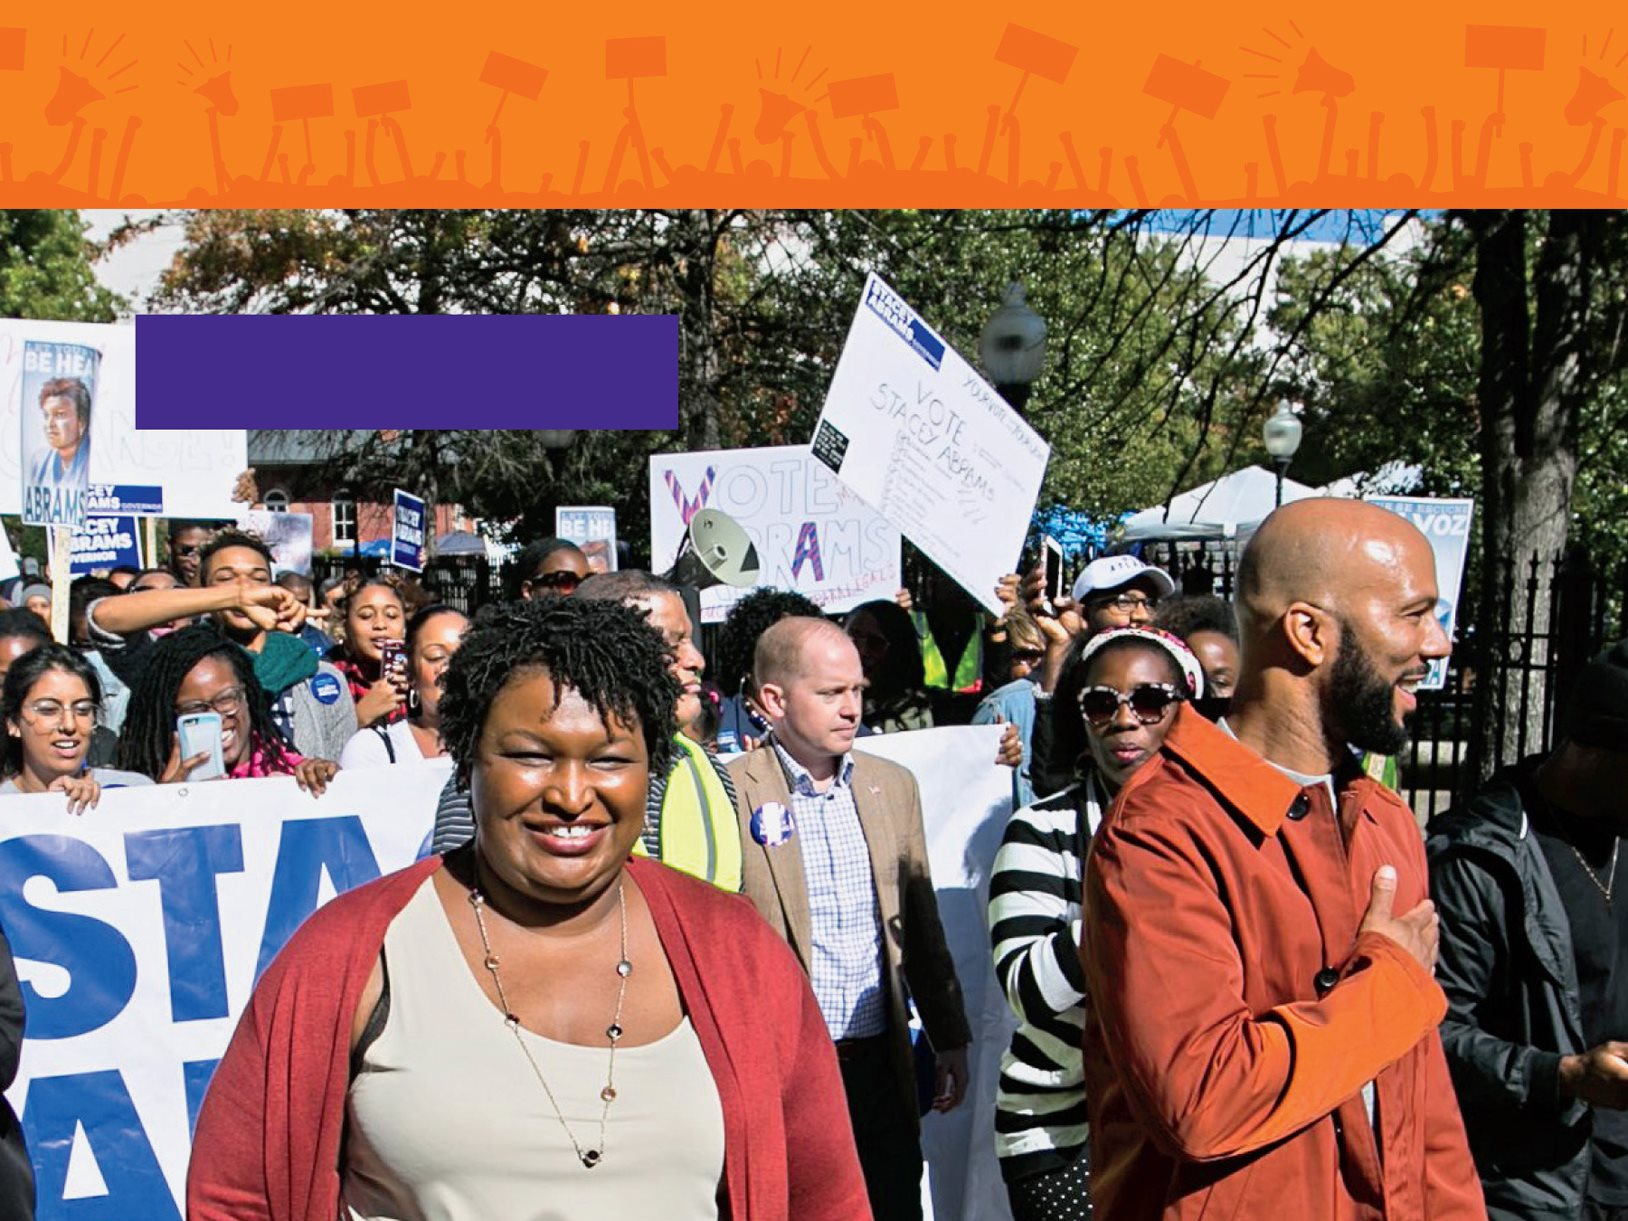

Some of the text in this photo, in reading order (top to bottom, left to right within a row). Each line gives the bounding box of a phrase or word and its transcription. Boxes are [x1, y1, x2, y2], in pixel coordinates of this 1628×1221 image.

[25, 351, 52, 373] BE
[870, 382, 940, 446] STACEY
[917, 380, 967, 447] VOTE
[24, 486, 86, 527] ABRAMS
[664, 458, 839, 527] VOTE
[1412, 513, 1467, 536] VOZ
[0, 814, 433, 1040] STA
